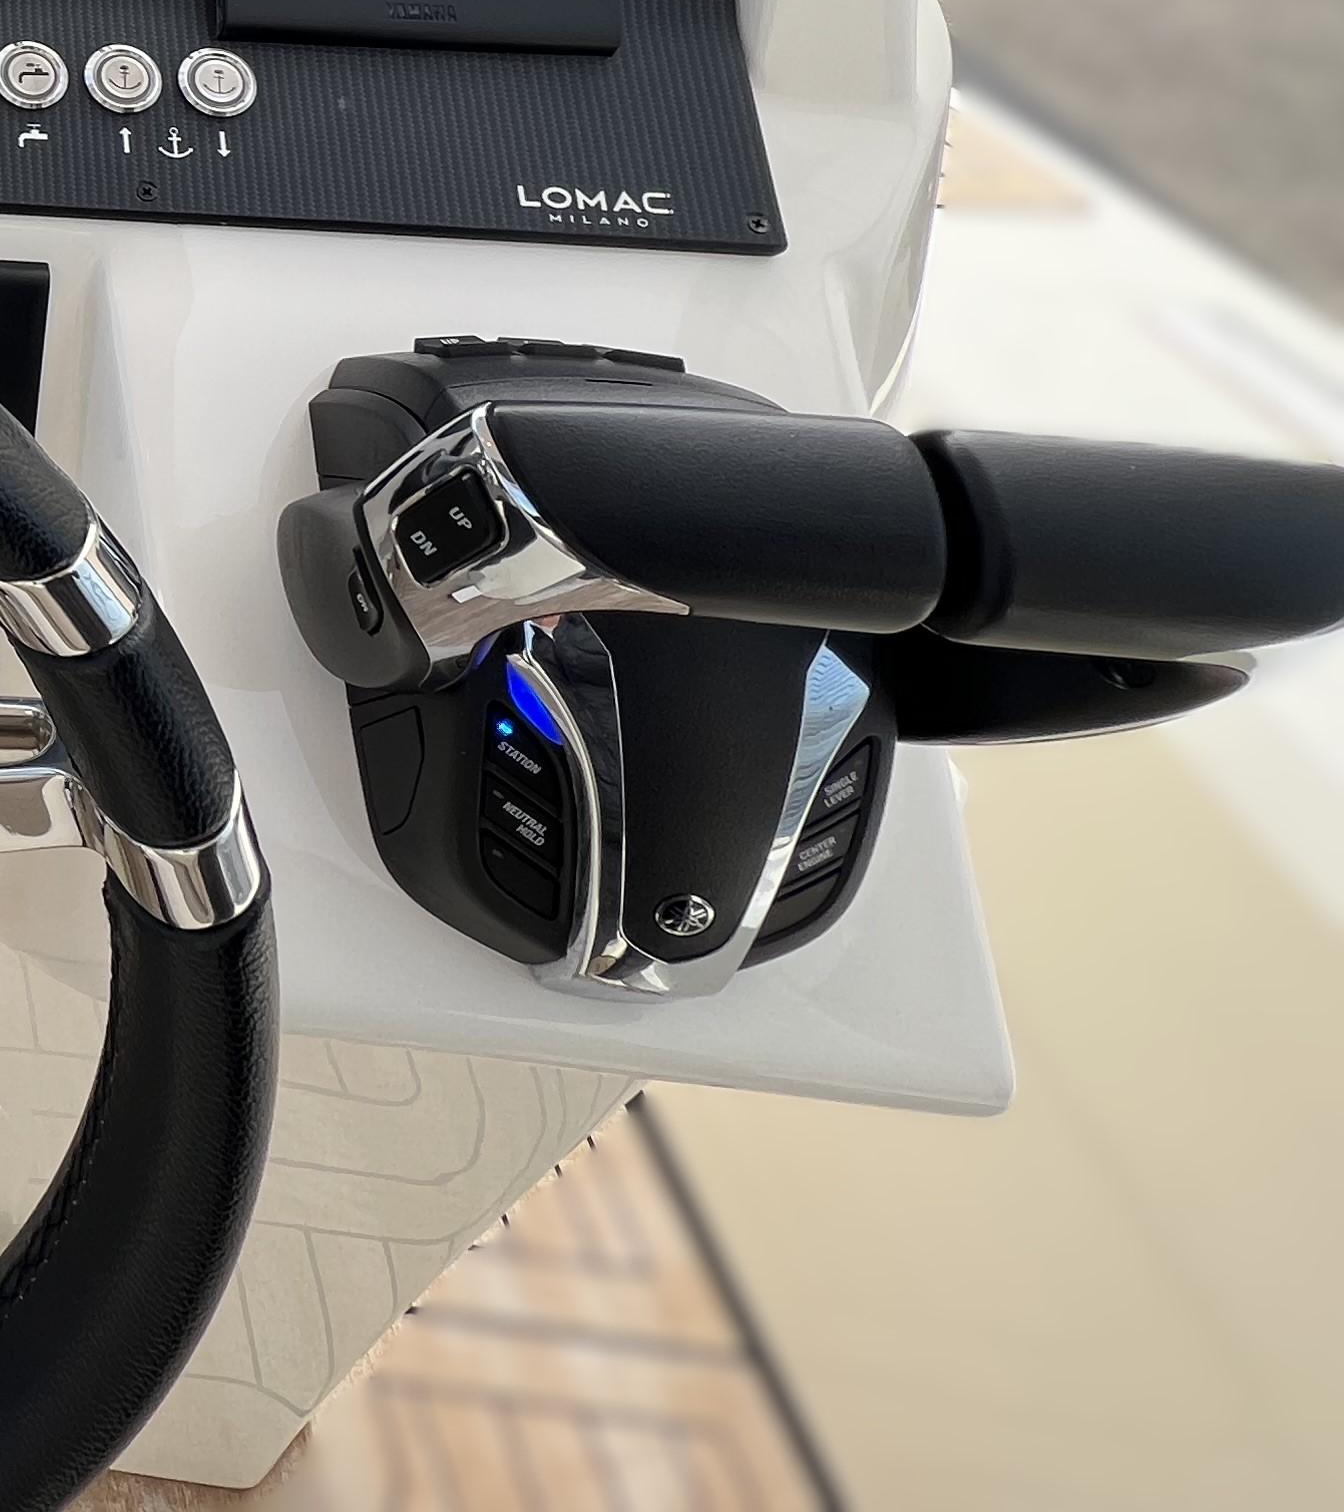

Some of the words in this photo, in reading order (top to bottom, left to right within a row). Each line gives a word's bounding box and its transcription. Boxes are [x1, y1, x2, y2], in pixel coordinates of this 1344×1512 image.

[516, 184, 675, 216] LOMAC
[549, 213, 649, 228] MILANO
[448, 506, 473, 530] UP
[409, 530, 438, 557] DN
[497, 740, 542, 775] STATION
[823, 785, 855, 808] LEVER
[502, 801, 547, 836] NEUTRAL
[516, 824, 545, 846] HOLD
[799, 836, 837, 860] CENTER
